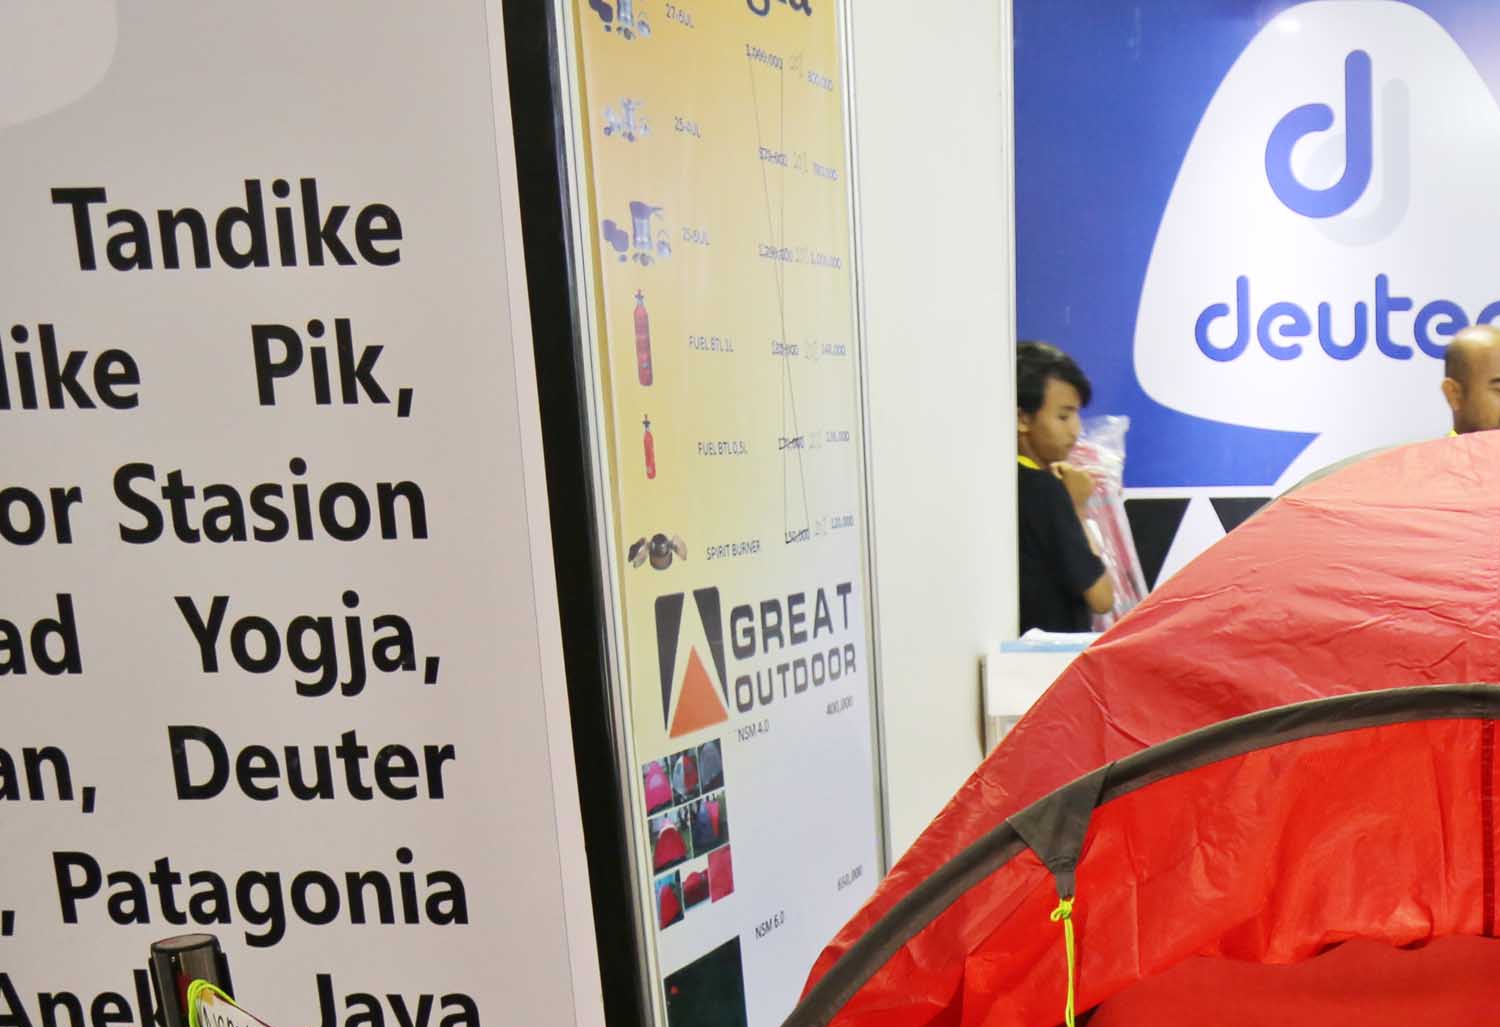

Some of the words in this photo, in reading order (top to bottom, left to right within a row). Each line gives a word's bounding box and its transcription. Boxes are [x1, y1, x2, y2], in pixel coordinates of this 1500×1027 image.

[51, 178, 403, 271] Tandike
[251, 318, 414, 417] Pik,
[113, 457, 428, 544] Stasion
[706, 543, 730, 561] SPIRIT
[731, 539, 761, 557] BURNER
[174, 590, 440, 697] Yogja,
[730, 581, 852, 661] GREAT
[735, 642, 857, 714] OUTDOOR
[167, 725, 456, 801] Deuter
[737, 722, 757, 743] NSM
[52, 847, 470, 948] Patagonia
